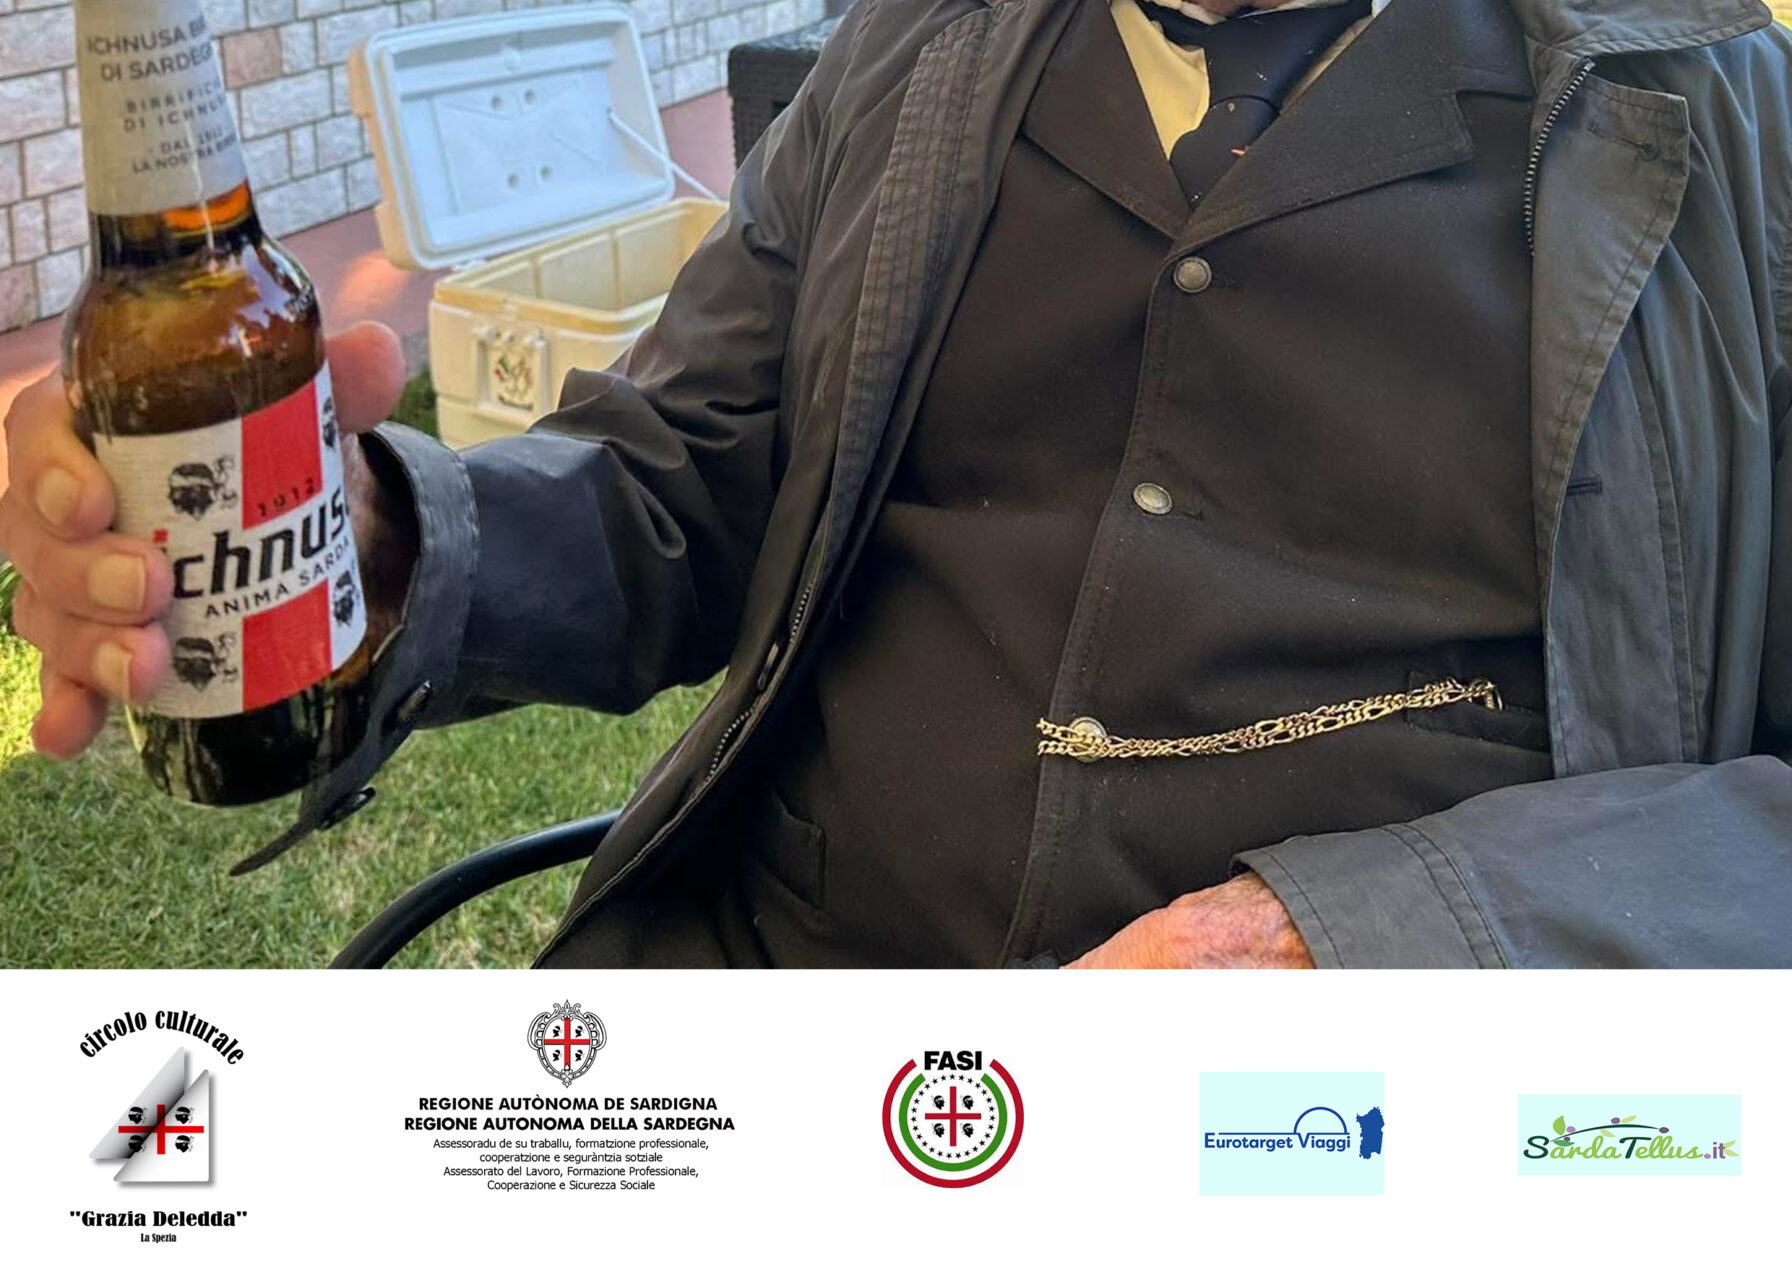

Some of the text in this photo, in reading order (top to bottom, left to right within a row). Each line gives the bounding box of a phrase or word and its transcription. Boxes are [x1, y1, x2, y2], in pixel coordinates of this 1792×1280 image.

[88, 26, 187, 55] ICHNUSA
[101, 63, 122, 81] DI
[124, 118, 145, 132] DI
[153, 486, 349, 599] chnus
[205, 582, 289, 618] ANIMA
